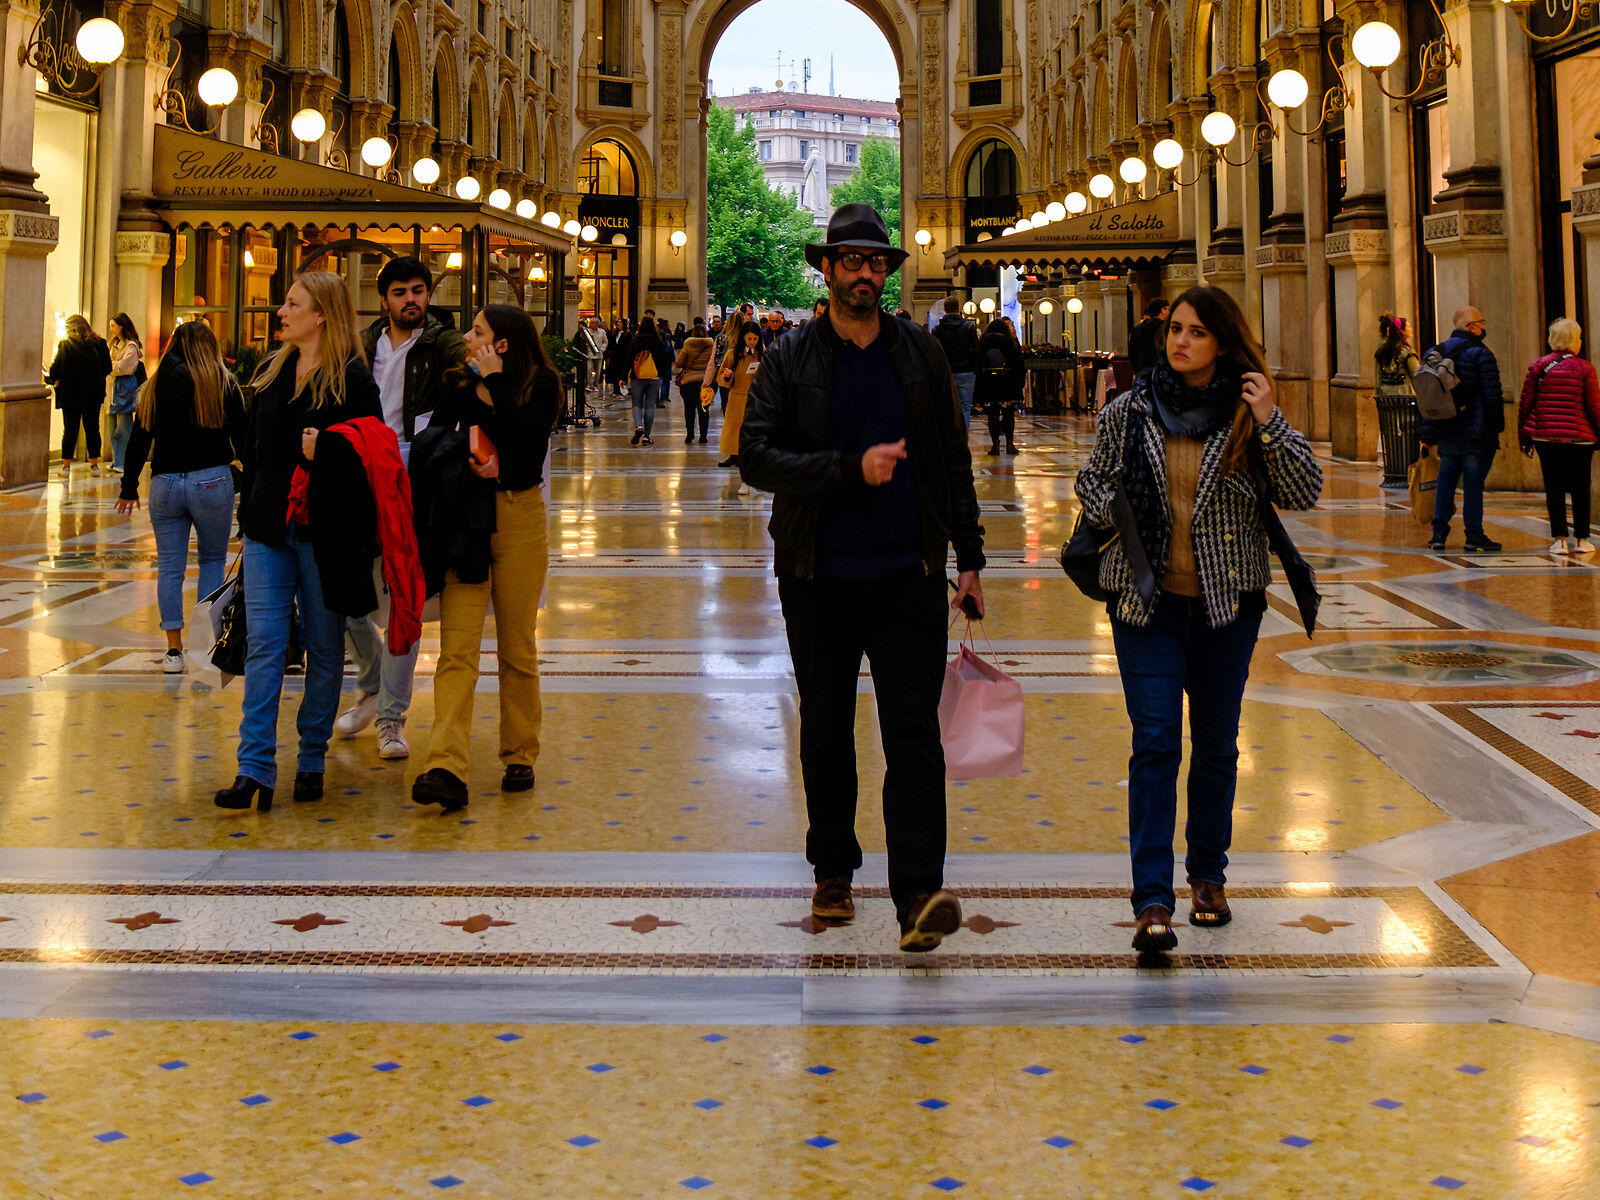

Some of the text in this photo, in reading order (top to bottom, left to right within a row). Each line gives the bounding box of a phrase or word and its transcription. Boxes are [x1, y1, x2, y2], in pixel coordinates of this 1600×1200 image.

[172, 150, 278, 180] Galleria
[173, 186, 254, 196] RESTAURANT
[262, 186, 299, 197] WOOD
[302, 187, 338, 197] OVEN
[582, 215, 629, 228] MONCLER
[970, 216, 1016, 227] MONTBLANC
[1089, 213, 1165, 231] il Salotto
